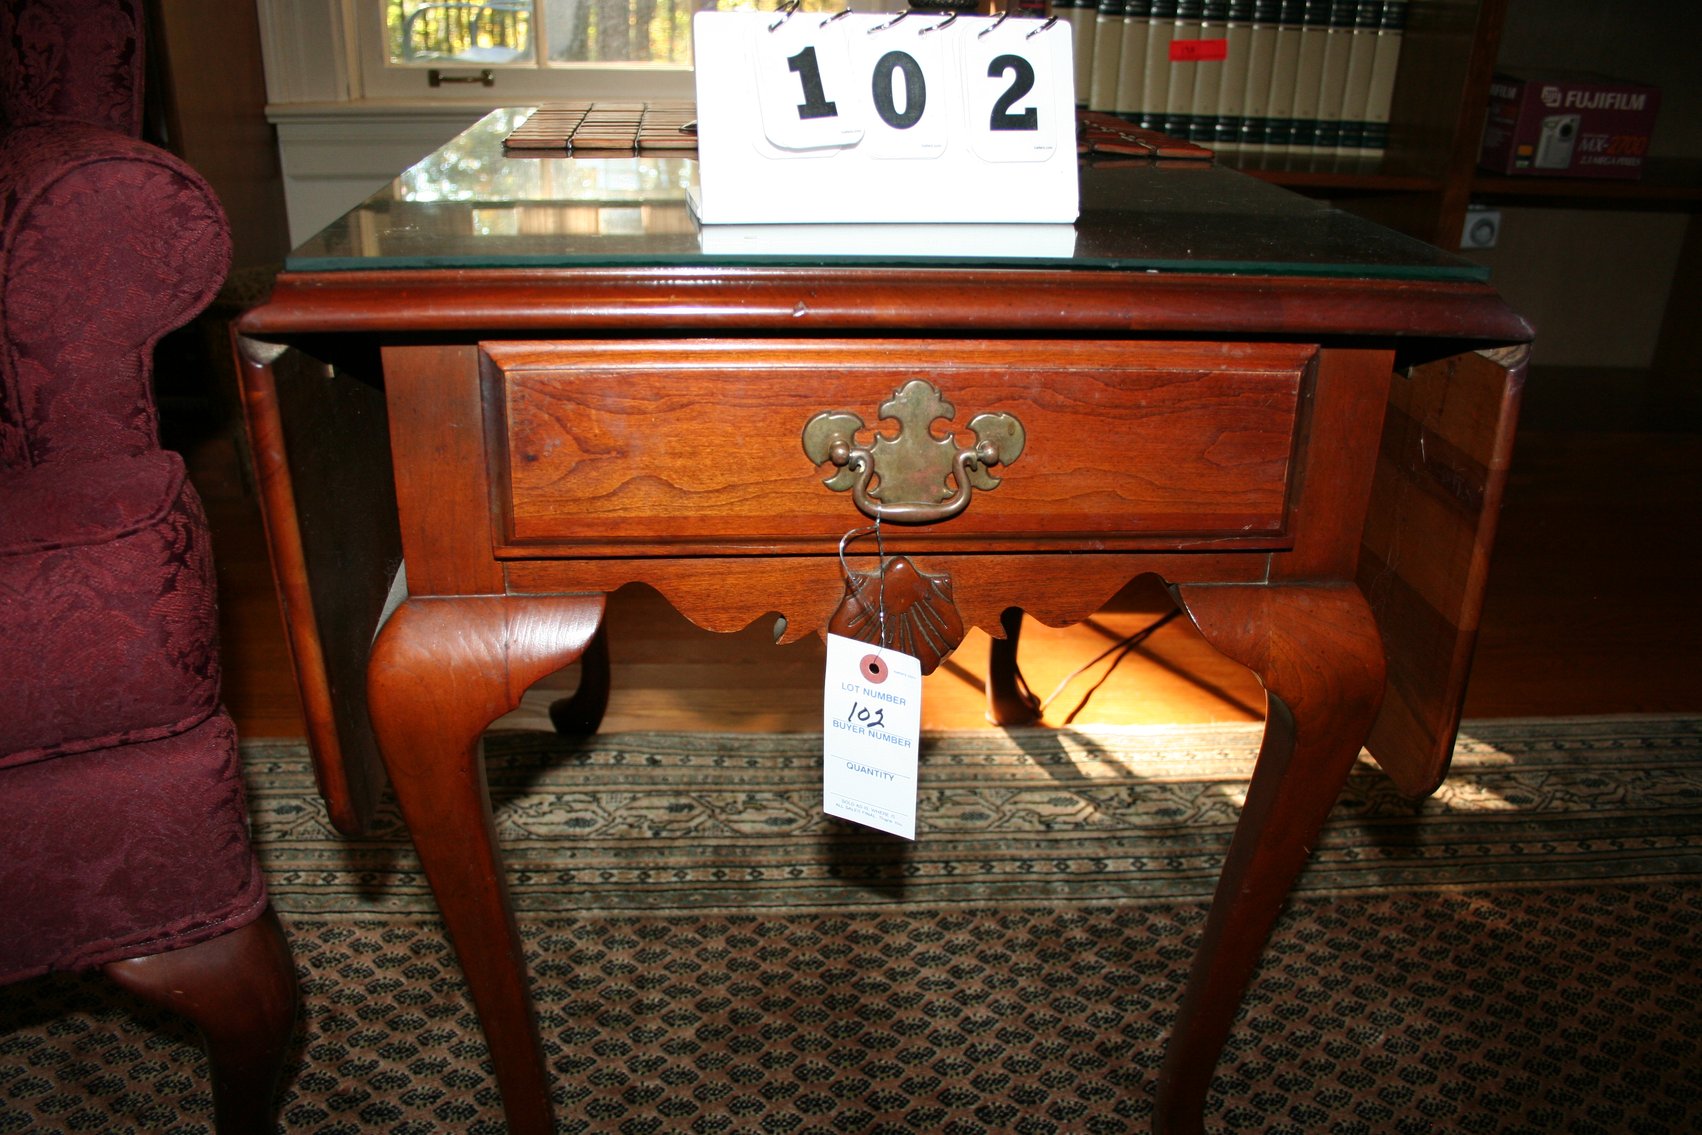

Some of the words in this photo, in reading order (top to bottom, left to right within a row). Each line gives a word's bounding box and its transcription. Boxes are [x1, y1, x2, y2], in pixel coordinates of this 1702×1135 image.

[1564, 90, 1647, 110] FUJIFILM
[841, 682, 859, 694] LOT
[863, 687, 906, 706] NUMBER
[847, 701, 885, 728] 102
[832, 719, 865, 735] BUYER
[868, 730, 911, 748] NUMBER
[846, 761, 895, 782] QUANTITY
